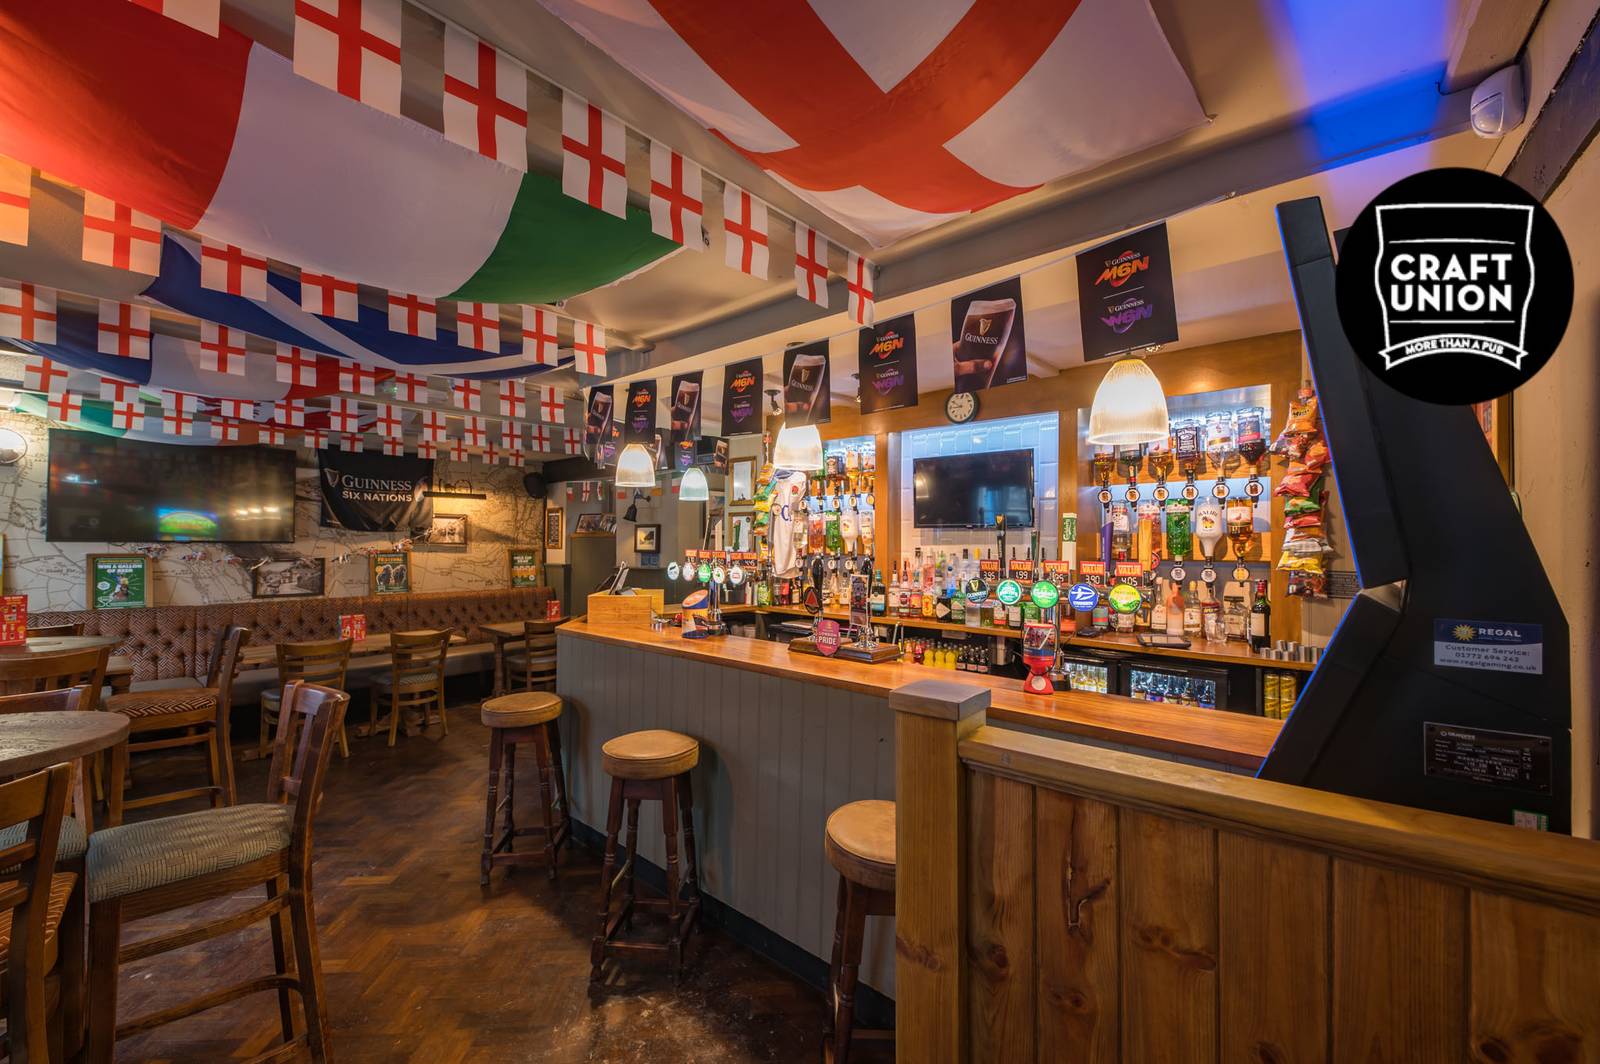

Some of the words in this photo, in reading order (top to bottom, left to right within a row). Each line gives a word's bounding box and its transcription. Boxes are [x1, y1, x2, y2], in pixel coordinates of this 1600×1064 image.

[1111, 252, 1141, 265] GUINNESS
[1114, 300, 1145, 312] GUINNESS
[965, 333, 999, 346] GUINNESS
[342, 474, 412, 491] GUINNESS
[342, 491, 361, 500] SIX
[363, 491, 412, 502] NATIONS
[1118, 567, 1141, 576] VALUE
[1085, 575, 1100, 584] 3.90
[1478, 628, 1521, 637] REGAL
[818, 636, 837, 645] PRIDE
[1445, 644, 1489, 654] Customer
